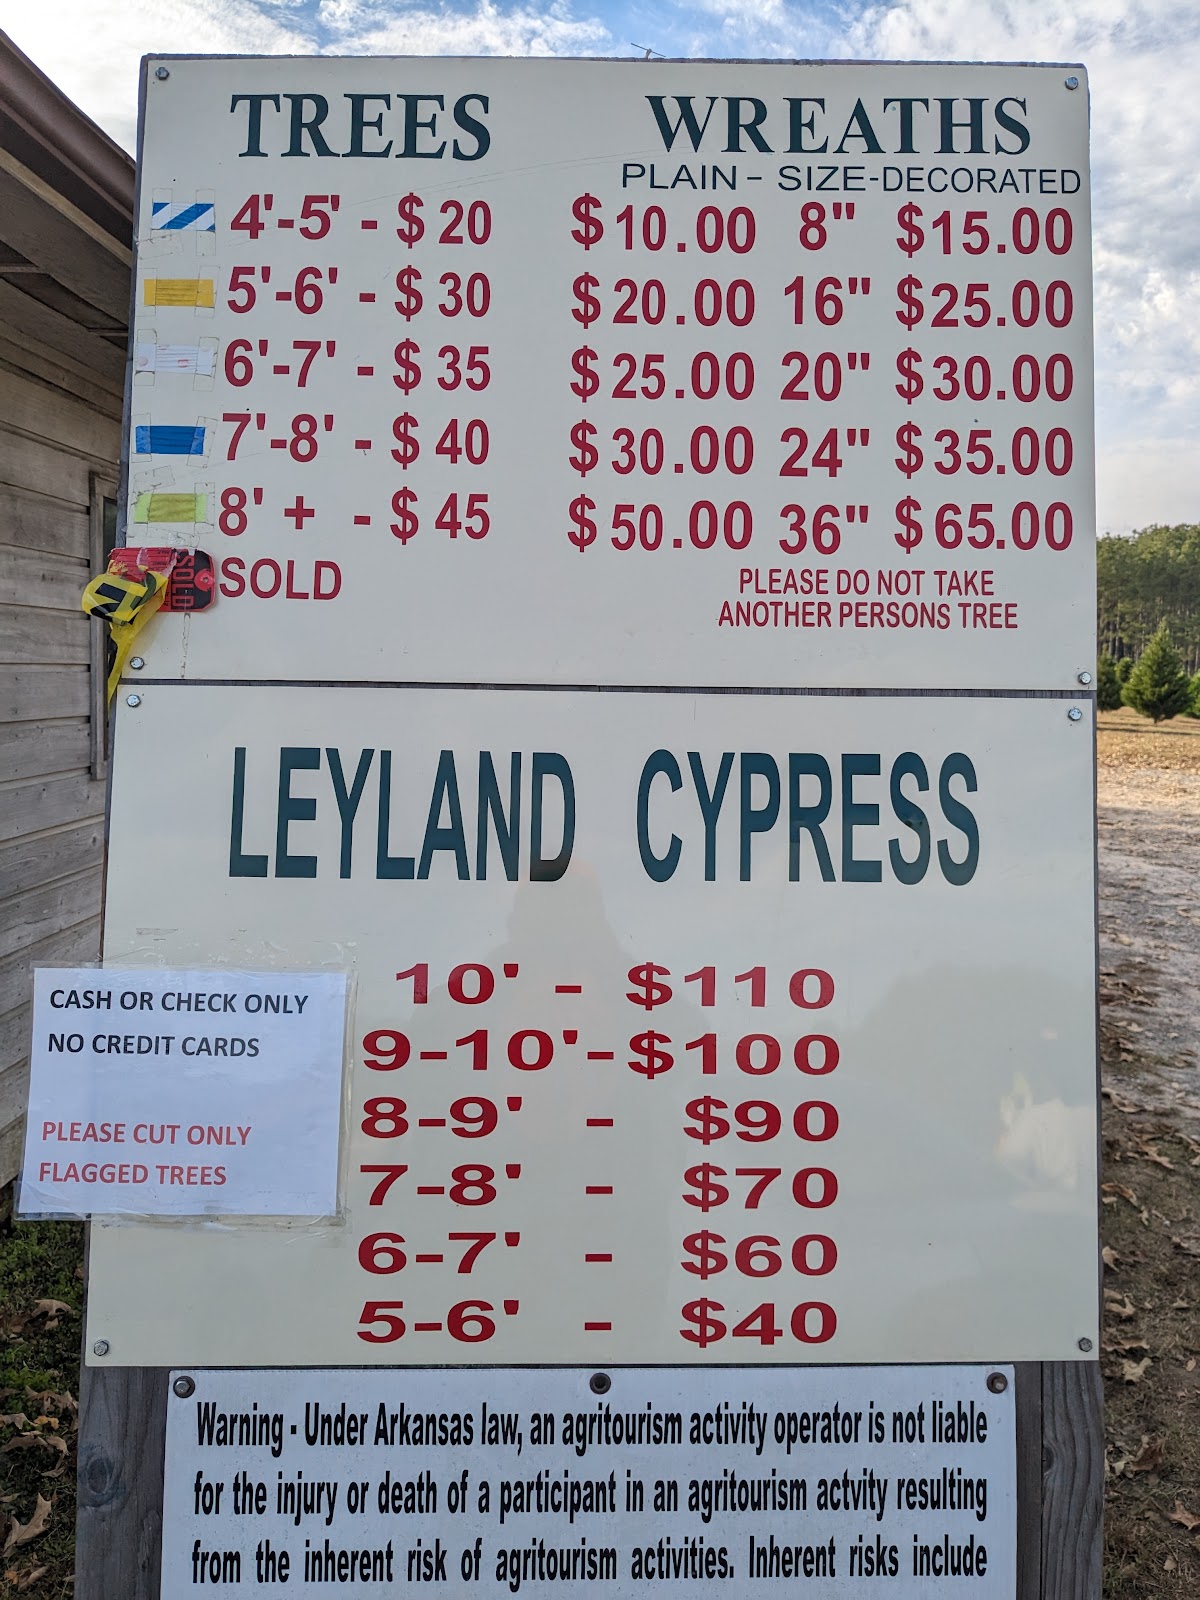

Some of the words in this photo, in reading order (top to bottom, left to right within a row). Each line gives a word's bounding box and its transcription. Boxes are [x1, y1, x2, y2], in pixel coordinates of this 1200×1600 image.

[230, 94, 490, 161] TREES
[645, 96, 1030, 155] WREATHS
[623, 164, 736, 190] PLAIN
[172, 554, 195, 607] SOLD
[219, 557, 341, 600] SOLD
[740, 569, 828, 594] PLEASE
[837, 570, 869, 595] DO
[878, 570, 925, 595] NOT
[934, 571, 994, 596] TAKE
[719, 601, 831, 627] ANOTHER
[840, 602, 950, 629] PERSONS
[958, 603, 1018, 628] TREE
[229, 747, 575, 882] LEYLAND
[637, 749, 979, 886] CYPRESS
[51, 990, 111, 1009] CASH
[120, 992, 153, 1010] OR
[162, 993, 237, 1012] CHECK
[245, 994, 308, 1013] ONLY
[626, 962, 834, 1011] $110
[49, 1034, 84, 1052] NO
[93, 1035, 175, 1055] CREDIT
[182, 1037, 259, 1057] CARDS
[43, 1122, 125, 1142] PLEASE
[134, 1124, 180, 1144] CUT
[187, 1126, 251, 1145] ONLY
[683, 1096, 839, 1145] $90
[40, 1163, 148, 1183] FLAGGED
[156, 1165, 226, 1185] TREES
[682, 1163, 838, 1212] $70
[681, 1230, 837, 1280] $60
[680, 1298, 837, 1348] $40
[197, 1402, 283, 1458] Warning
[305, 1403, 368, 1446] Under
[374, 1403, 473, 1445] Arkansas
[482, 1402, 522, 1456] law,
[530, 1413, 554, 1445] an
[562, 1402, 682, 1456] agritourism
[690, 1402, 767, 1455] activity
[774, 1401, 862, 1454] operator
[869, 1401, 884, 1443] is
[893, 1402, 924, 1443] not
[933, 1401, 987, 1443] liable
[194, 1471, 224, 1515] for
[233, 1471, 266, 1515] the
[277, 1471, 338, 1526] injury
[347, 1482, 369, 1514] or
[378, 1470, 437, 1514] death
[448, 1470, 468, 1513] of
[478, 1481, 489, 1513] a
[500, 1470, 616, 1524] participant
[626, 1469, 643, 1512] in
[654, 1480, 678, 1511] an
[688, 1469, 806, 1523] agritourism
[817, 1468, 888, 1521] actvity
[898, 1468, 986, 1521] resulting
[192, 1540, 240, 1583] from
[256, 1540, 289, 1583] the
[305, 1539, 393, 1582] inherent
[408, 1539, 447, 1581] risk
[461, 1538, 482, 1581] of
[496, 1537, 616, 1592] agritourism
[631, 1536, 734, 1579] activities.
[750, 1535, 835, 1578] Inherent
[850, 1534, 898, 1576] risks
[914, 1534, 987, 1576] include
